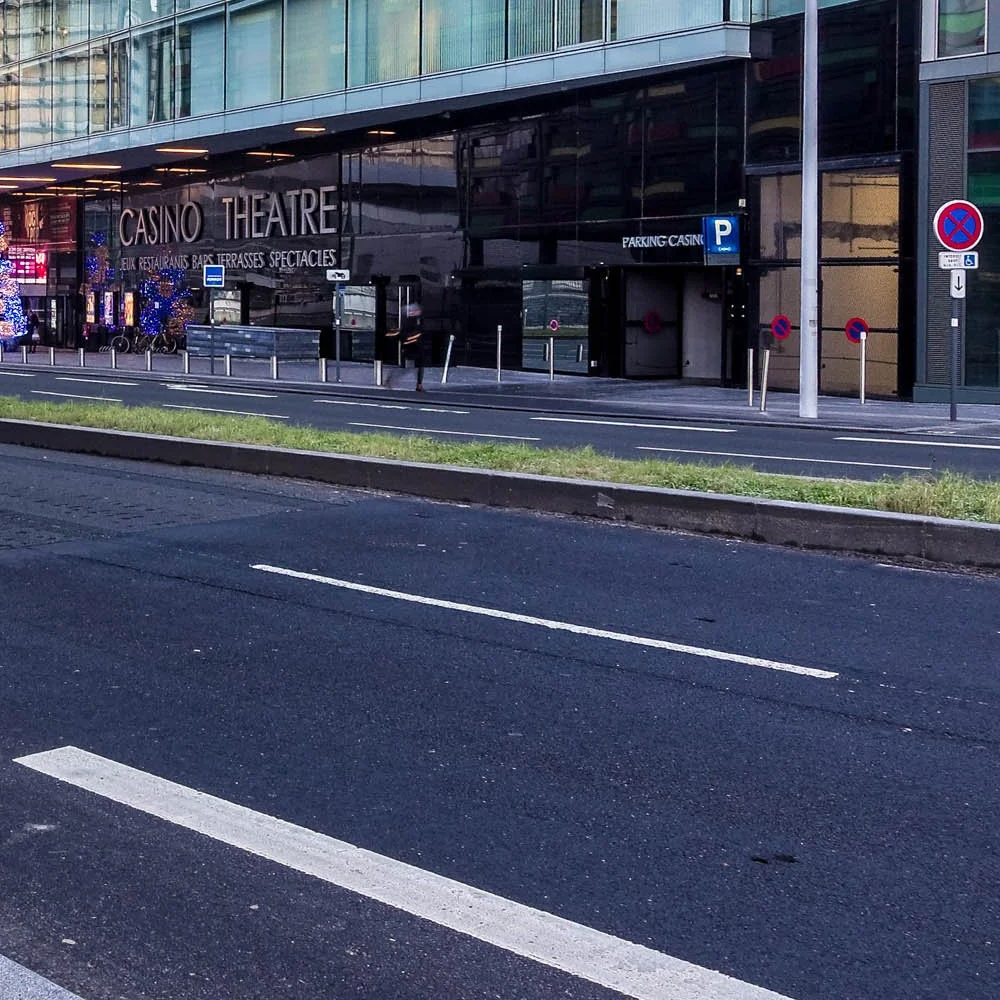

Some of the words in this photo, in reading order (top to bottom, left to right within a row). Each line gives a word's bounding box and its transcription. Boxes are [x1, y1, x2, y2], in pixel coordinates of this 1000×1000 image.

[119, 201, 202, 246] CASINO
[222, 185, 338, 240] THEATRE
[622, 235, 667, 249] PARKING
[714, 219, 732, 245] P
[119, 257, 136, 271] JEUX
[139, 254, 189, 271] RESTAURANTS
[217, 252, 265, 269] TERRASSES
[269, 249, 337, 268] SPECTACLES
